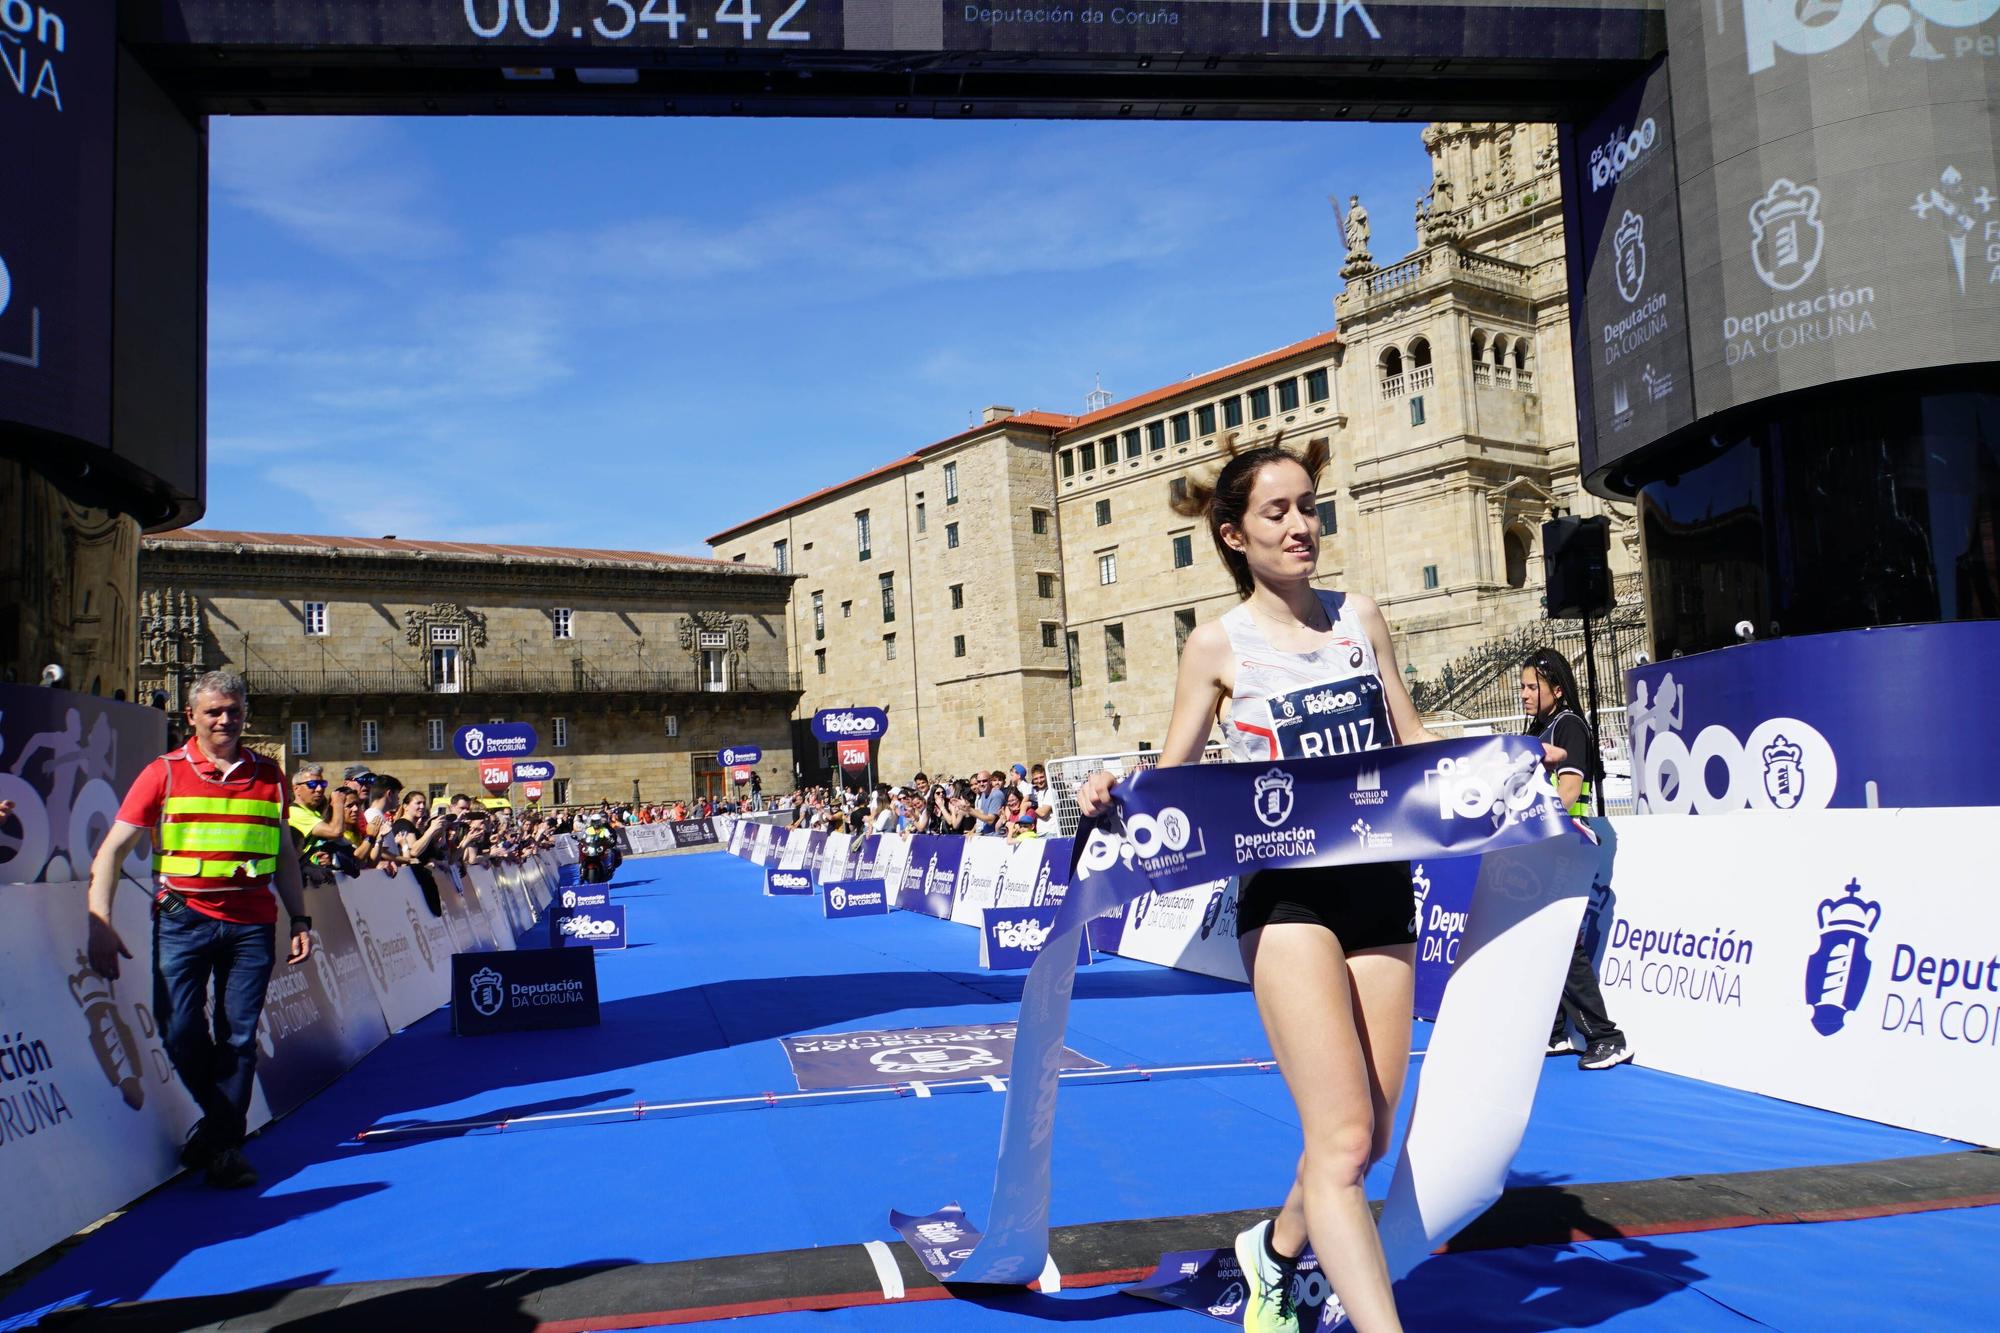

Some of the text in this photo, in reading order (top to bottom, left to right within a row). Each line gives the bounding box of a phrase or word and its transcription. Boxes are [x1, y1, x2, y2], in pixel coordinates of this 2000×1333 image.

[964, 5, 1179, 25] Deputación da Coruña
[1604, 293, 1667, 344] Deputación
[1724, 286, 1875, 340] Deputación
[1606, 313, 1668, 365] DA CORUÑA
[1725, 339, 1757, 367] DA
[486, 737, 526, 747] Deputación
[498, 742, 527, 752] CORUÑA
[1300, 718, 1382, 759] RUIZ
[843, 749, 866, 765] 25M
[484, 768, 509, 785] 25M
[1350, 790, 1389, 800] CONCELLO DE
[1354, 797, 1384, 806] SANTIAGO
[1235, 826, 1316, 849] Deputación
[1236, 841, 1317, 864] DA CORUÑA
[848, 891, 881, 903] Deputación
[1153, 892, 1195, 910] Deputación
[1422, 936, 1442, 963] DA
[1612, 918, 1753, 965] Deputación
[511, 979, 583, 997] Deputación
[1604, 957, 1742, 1008] DA CORUÑA
[511, 991, 584, 1008] DA CORUÑA
[1881, 993, 1925, 1036] DA
